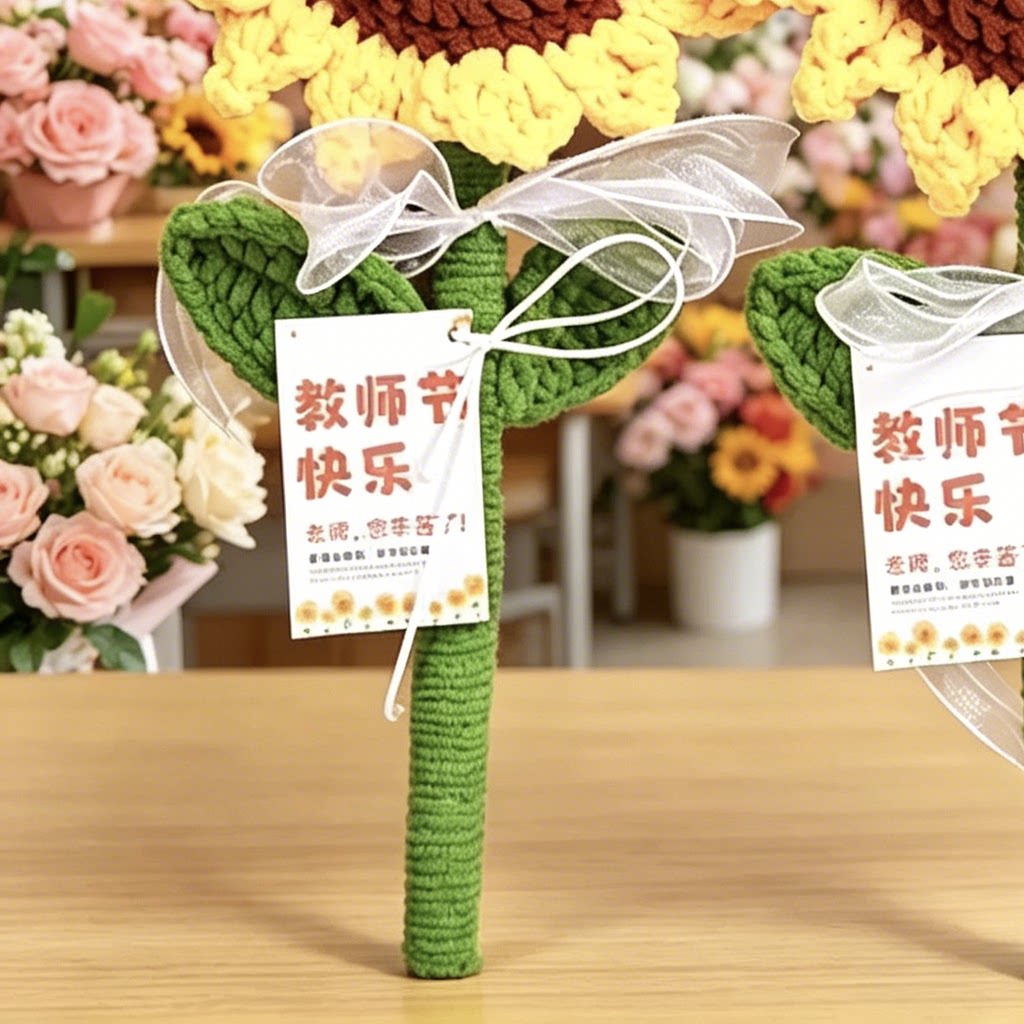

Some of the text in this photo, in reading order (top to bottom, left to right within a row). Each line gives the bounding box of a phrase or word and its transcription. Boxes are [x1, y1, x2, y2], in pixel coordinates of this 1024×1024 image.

[295, 369, 468, 431] 教师节
[296, 441, 412, 500] 快乐
[874, 473, 993, 532] 快乐
